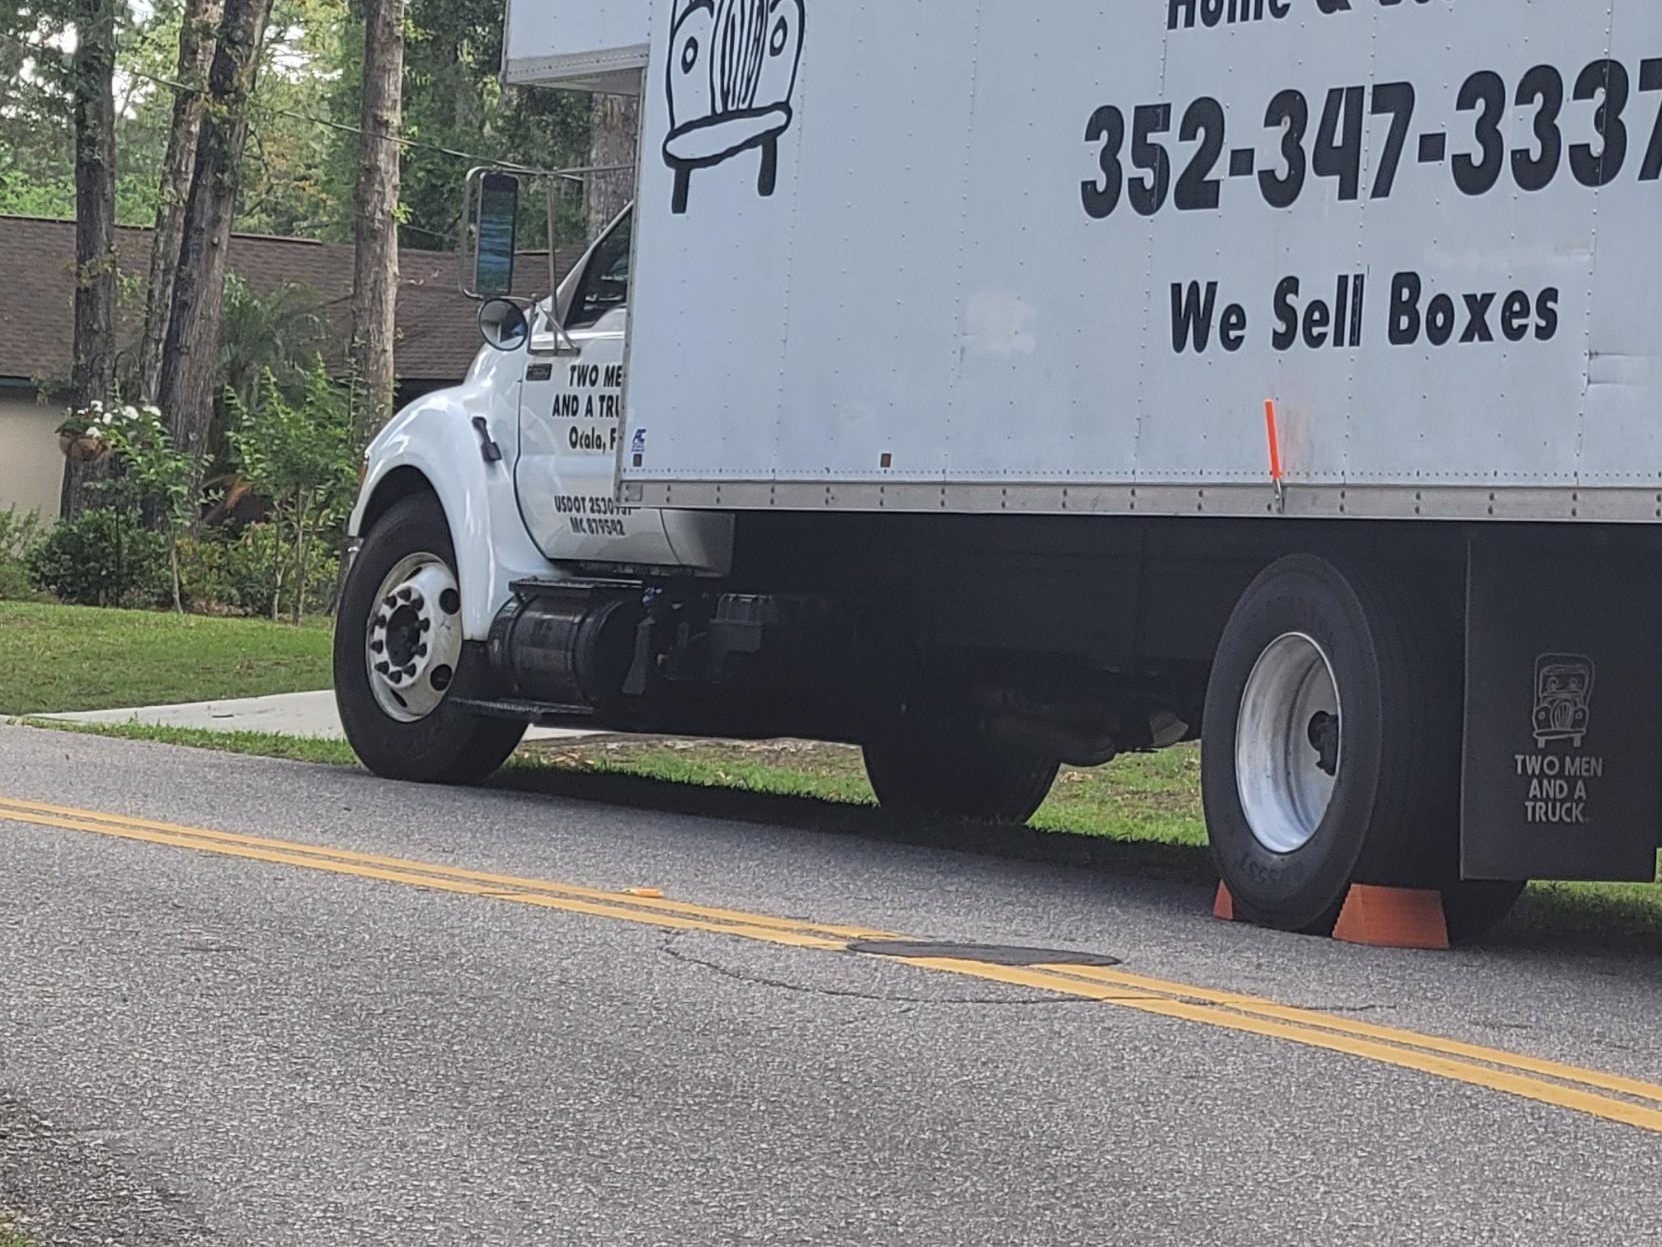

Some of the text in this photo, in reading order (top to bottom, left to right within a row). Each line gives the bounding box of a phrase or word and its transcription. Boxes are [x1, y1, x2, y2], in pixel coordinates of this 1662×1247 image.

[1170, 271, 1559, 353] We Sell Boxes
[569, 364, 599, 388] TWO
[603, 364, 622, 388] ME
[552, 394, 579, 417] AND
[585, 394, 594, 418] A
[568, 425, 606, 453] Ocala,
[554, 495, 586, 513] USDOT
[1514, 754, 1603, 777] TWO MEN
[1528, 778, 1587, 800] AND A
[1525, 801, 1584, 823] TRUCK
